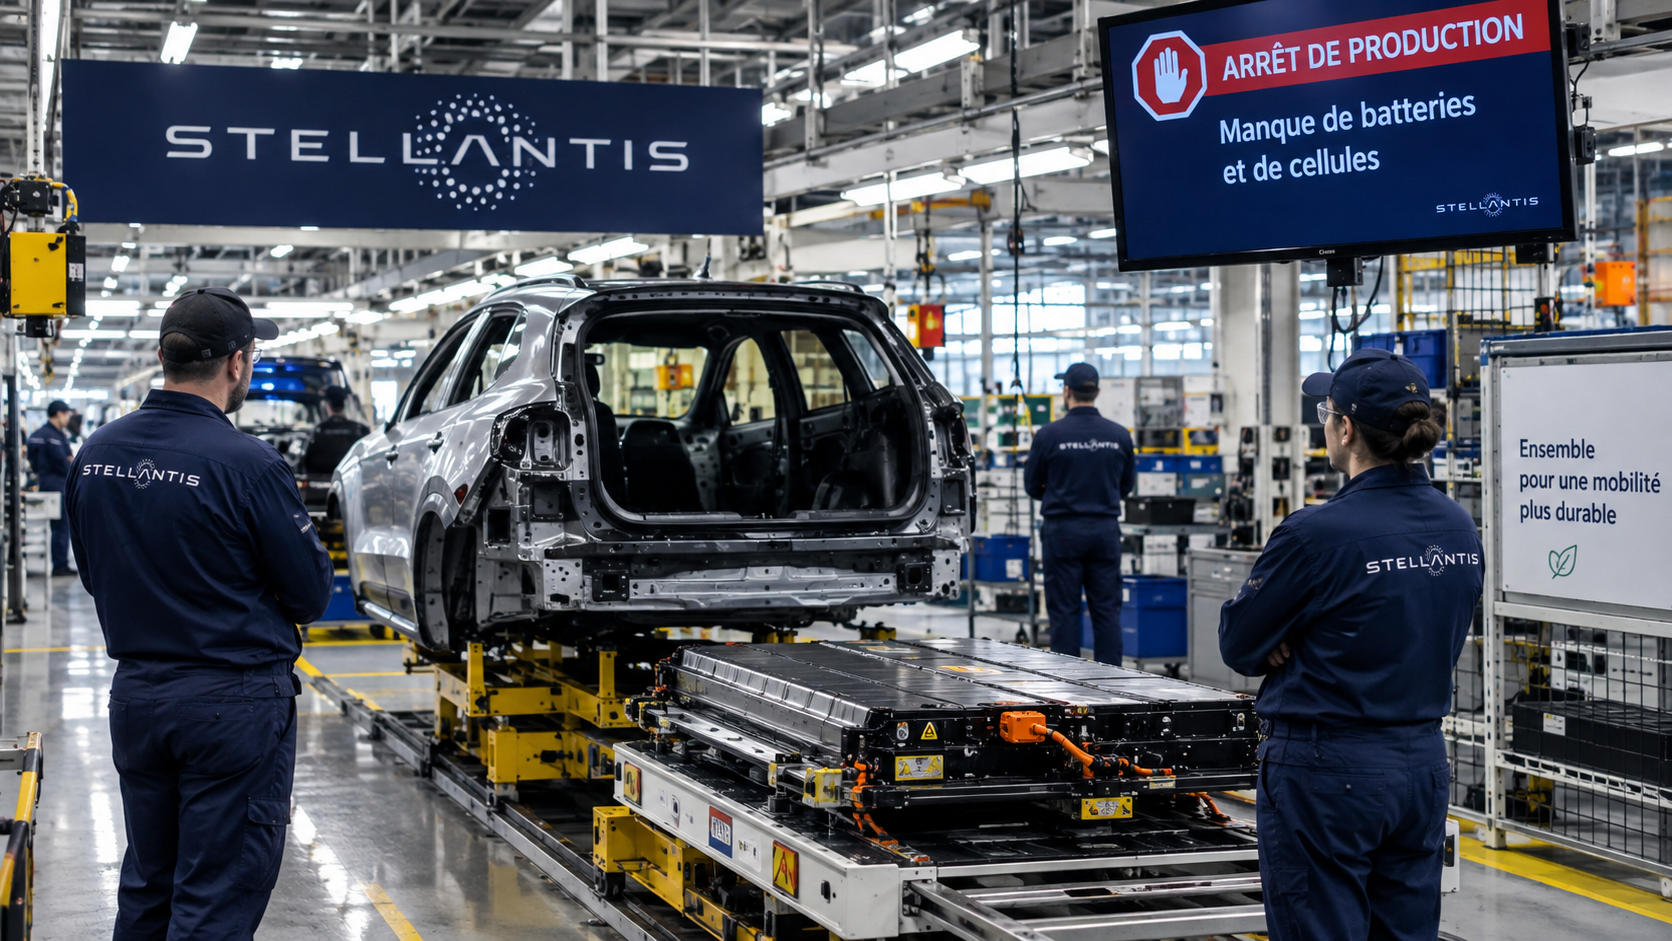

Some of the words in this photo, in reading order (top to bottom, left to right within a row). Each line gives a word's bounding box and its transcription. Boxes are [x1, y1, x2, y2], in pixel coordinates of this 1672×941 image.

[1222, 41, 1300, 81] ARRÊT
[1308, 40, 1342, 69] DE
[1349, 13, 1524, 64] PRODUCTION
[1219, 115, 1315, 145] Manque
[1323, 105, 1353, 132] de
[1361, 91, 1476, 127] batteries
[165, 125, 689, 172] STELLANTIS
[1223, 159, 1246, 184] et
[1254, 155, 1282, 181] de
[1289, 146, 1380, 177] cellules
[1435, 196, 1539, 213] STELLANTIS
[1059, 441, 1120, 450] STELLANTIS
[1519, 438, 1596, 460] Ensemble
[82, 464, 201, 487] STELLANTIS
[1519, 473, 1554, 493] pour
[1559, 474, 1588, 490] une
[1593, 470, 1661, 494] mobilité
[1520, 499, 1551, 523] plus
[1556, 501, 1617, 525] durable
[1366, 553, 1479, 574] STELLANTIS
